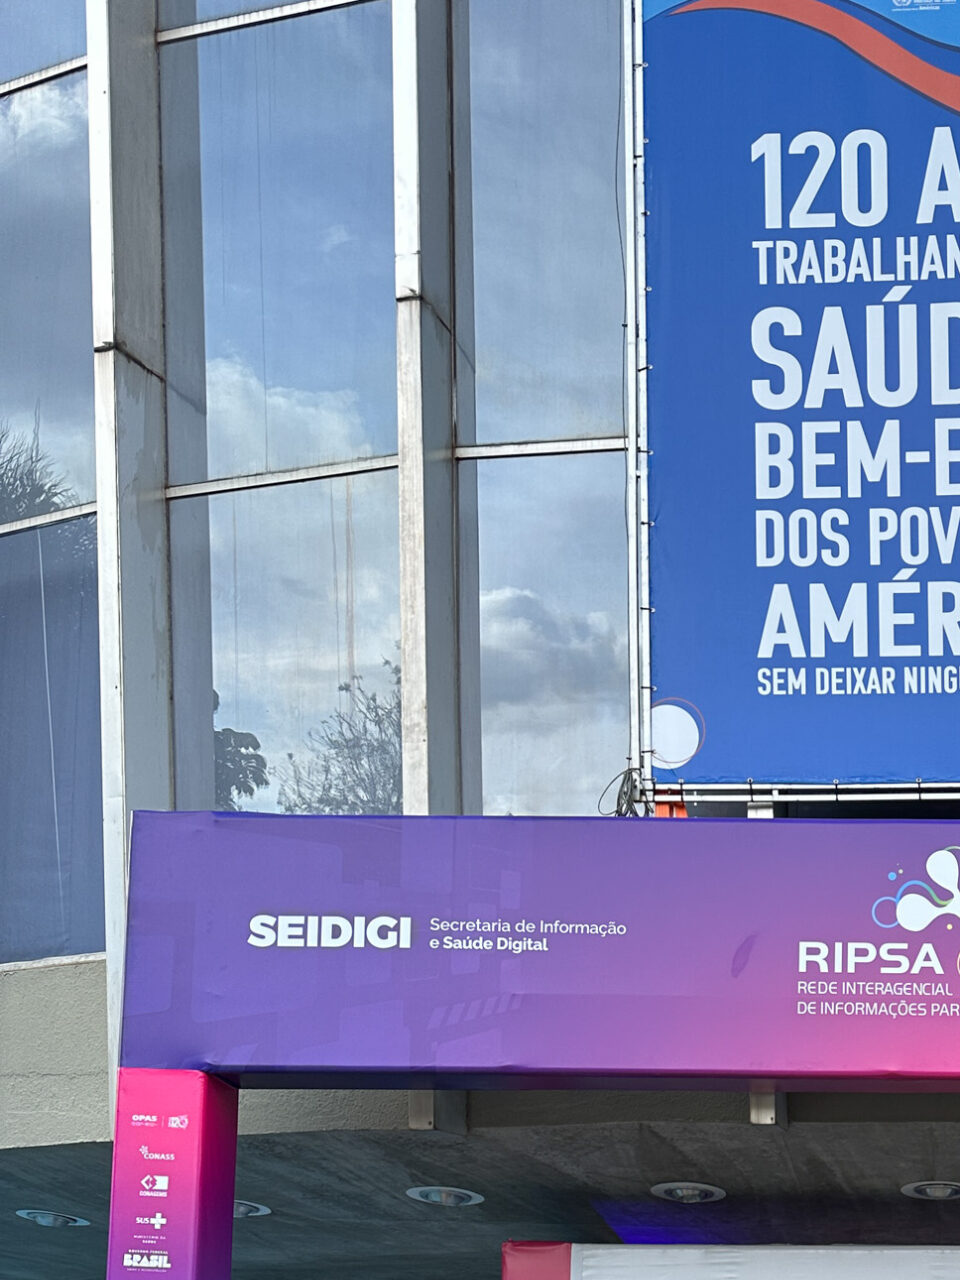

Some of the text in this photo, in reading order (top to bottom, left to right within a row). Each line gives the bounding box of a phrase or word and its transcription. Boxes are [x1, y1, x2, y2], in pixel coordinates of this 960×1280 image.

[750, 129, 888, 229] 120
[755, 508, 850, 568] DOS
[757, 667, 807, 696] SEM
[815, 666, 896, 695] DEIXAR
[247, 914, 412, 949] SEIDIGI
[429, 917, 627, 937] Secretaria de Informação
[429, 936, 549, 954] e Saúde Digital
[798, 941, 945, 974] RIPSA
[797, 980, 953, 996] REDE INTERAGENCIAL
[797, 1001, 817, 1015] DE
[820, 1000, 927, 1019] INFORMAÇÕES
[131, 1114, 158, 1122] OPAS
[143, 1153, 175, 1161] CONASS
[135, 1216, 150, 1225] SUS
[123, 1253, 171, 1269] BRASIL
